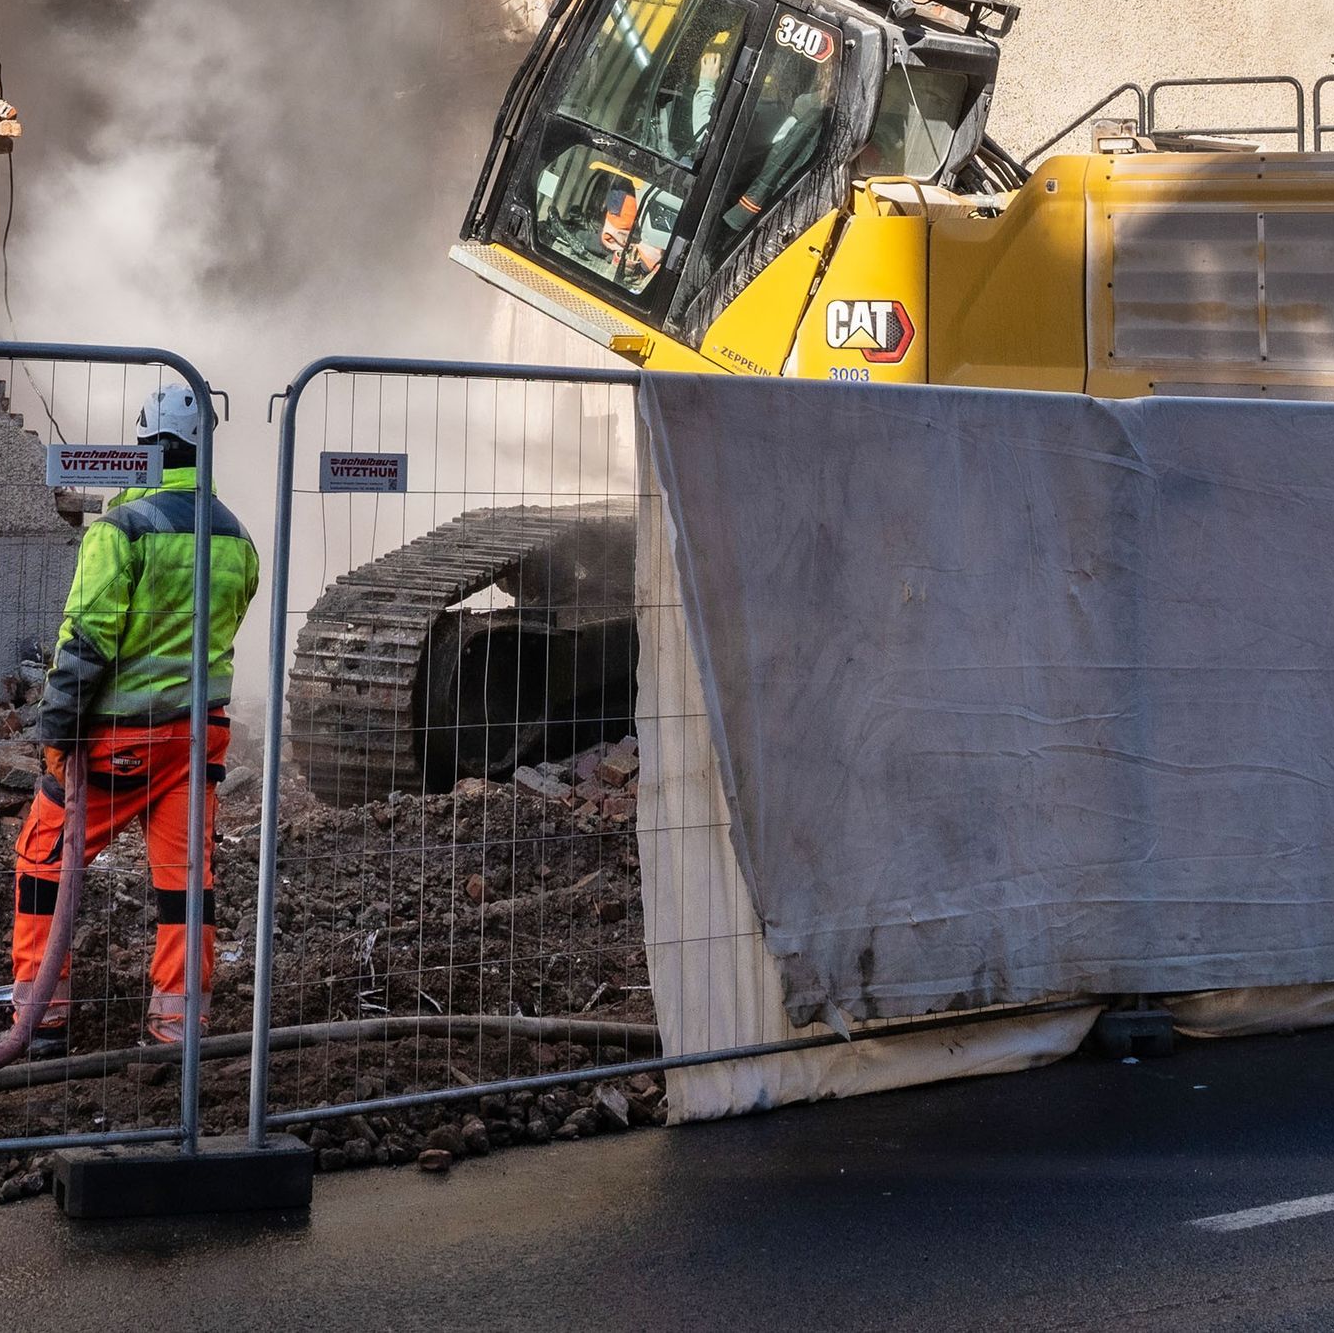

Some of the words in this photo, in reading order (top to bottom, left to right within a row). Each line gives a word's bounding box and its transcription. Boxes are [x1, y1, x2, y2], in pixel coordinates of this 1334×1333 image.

[778, 16, 823, 56] 340
[827, 300, 893, 349] CAT
[720, 346, 772, 377] ZEPPELIN
[828, 367, 871, 382] 3003
[61, 460, 147, 471] VITZTHUM
[330, 466, 398, 478] VITZTHUM
